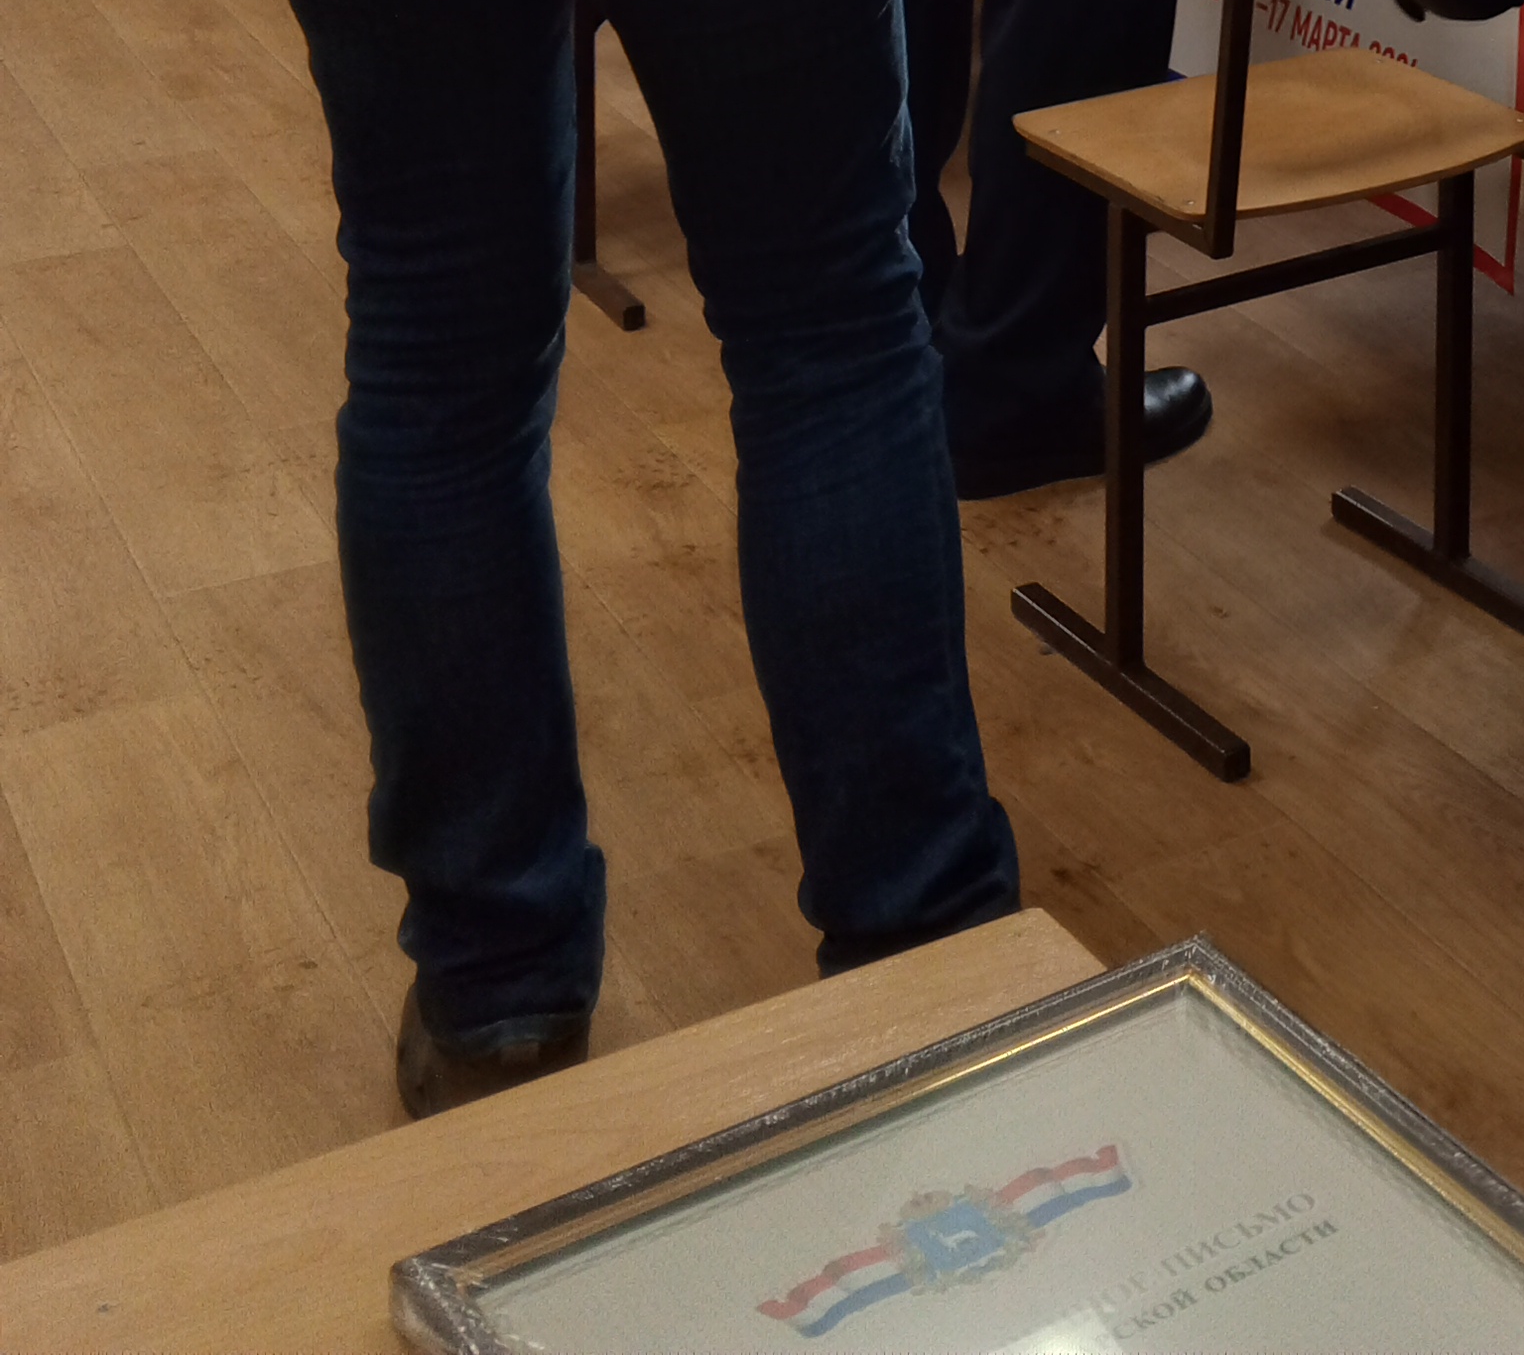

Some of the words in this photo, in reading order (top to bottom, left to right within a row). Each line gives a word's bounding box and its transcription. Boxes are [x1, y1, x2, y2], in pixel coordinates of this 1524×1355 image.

[1111, 1287, 1199, 1340] СКОЙ
[1203, 1218, 1340, 1294] ОБЛАСТИ
[1161, 1192, 1316, 1277] ПИСЬМО
